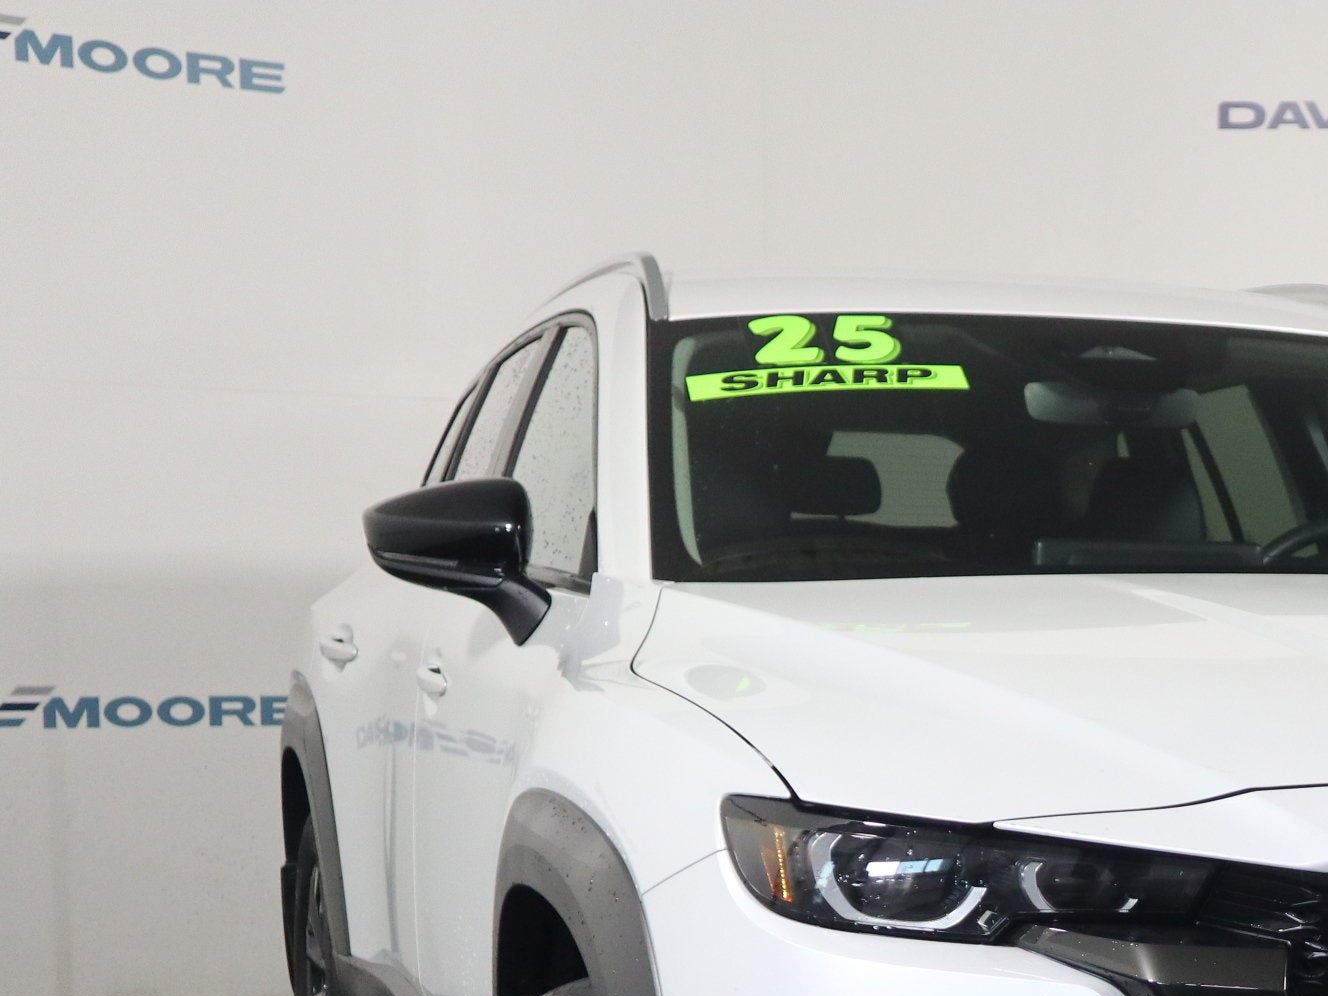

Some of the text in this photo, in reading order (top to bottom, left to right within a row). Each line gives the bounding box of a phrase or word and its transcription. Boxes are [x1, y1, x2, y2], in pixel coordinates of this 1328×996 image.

[14, 29, 286, 95] MOORE
[748, 315, 901, 366] 25
[720, 367, 935, 393] SHARP
